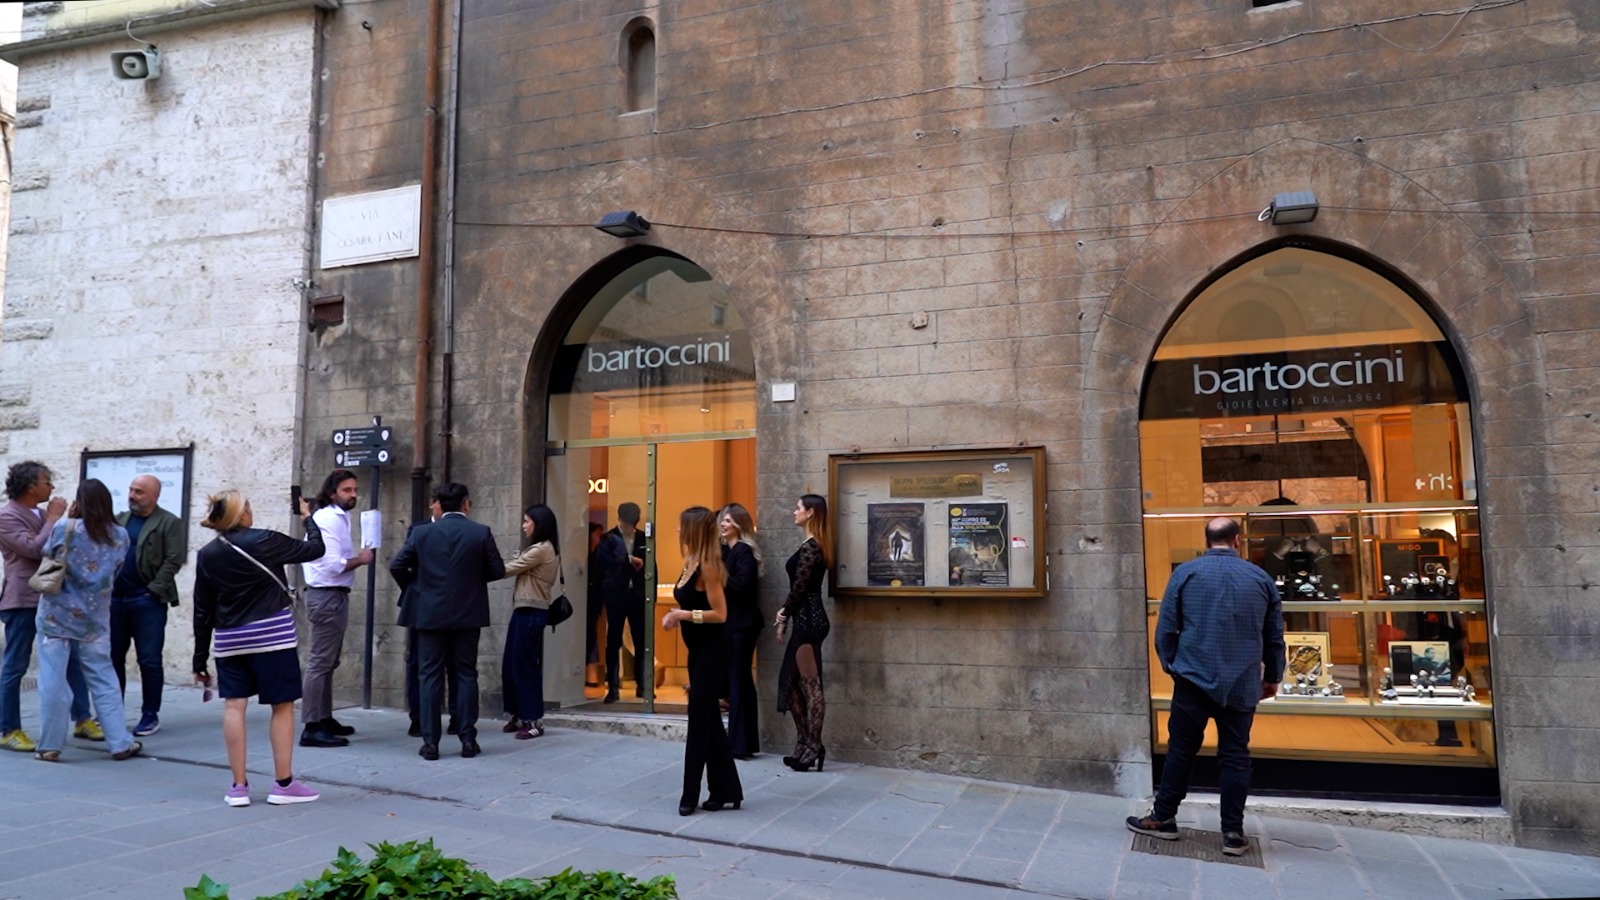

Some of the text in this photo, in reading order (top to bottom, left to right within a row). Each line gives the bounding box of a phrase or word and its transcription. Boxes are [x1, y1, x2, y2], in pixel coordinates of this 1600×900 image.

[361, 208, 379, 220] VIA
[336, 230, 403, 248] CESARE FANI
[587, 335, 730, 373] bartoccini
[1193, 349, 1404, 395] bartoccini
[1216, 392, 1382, 411] GIOIELLERIA DAL 1964
